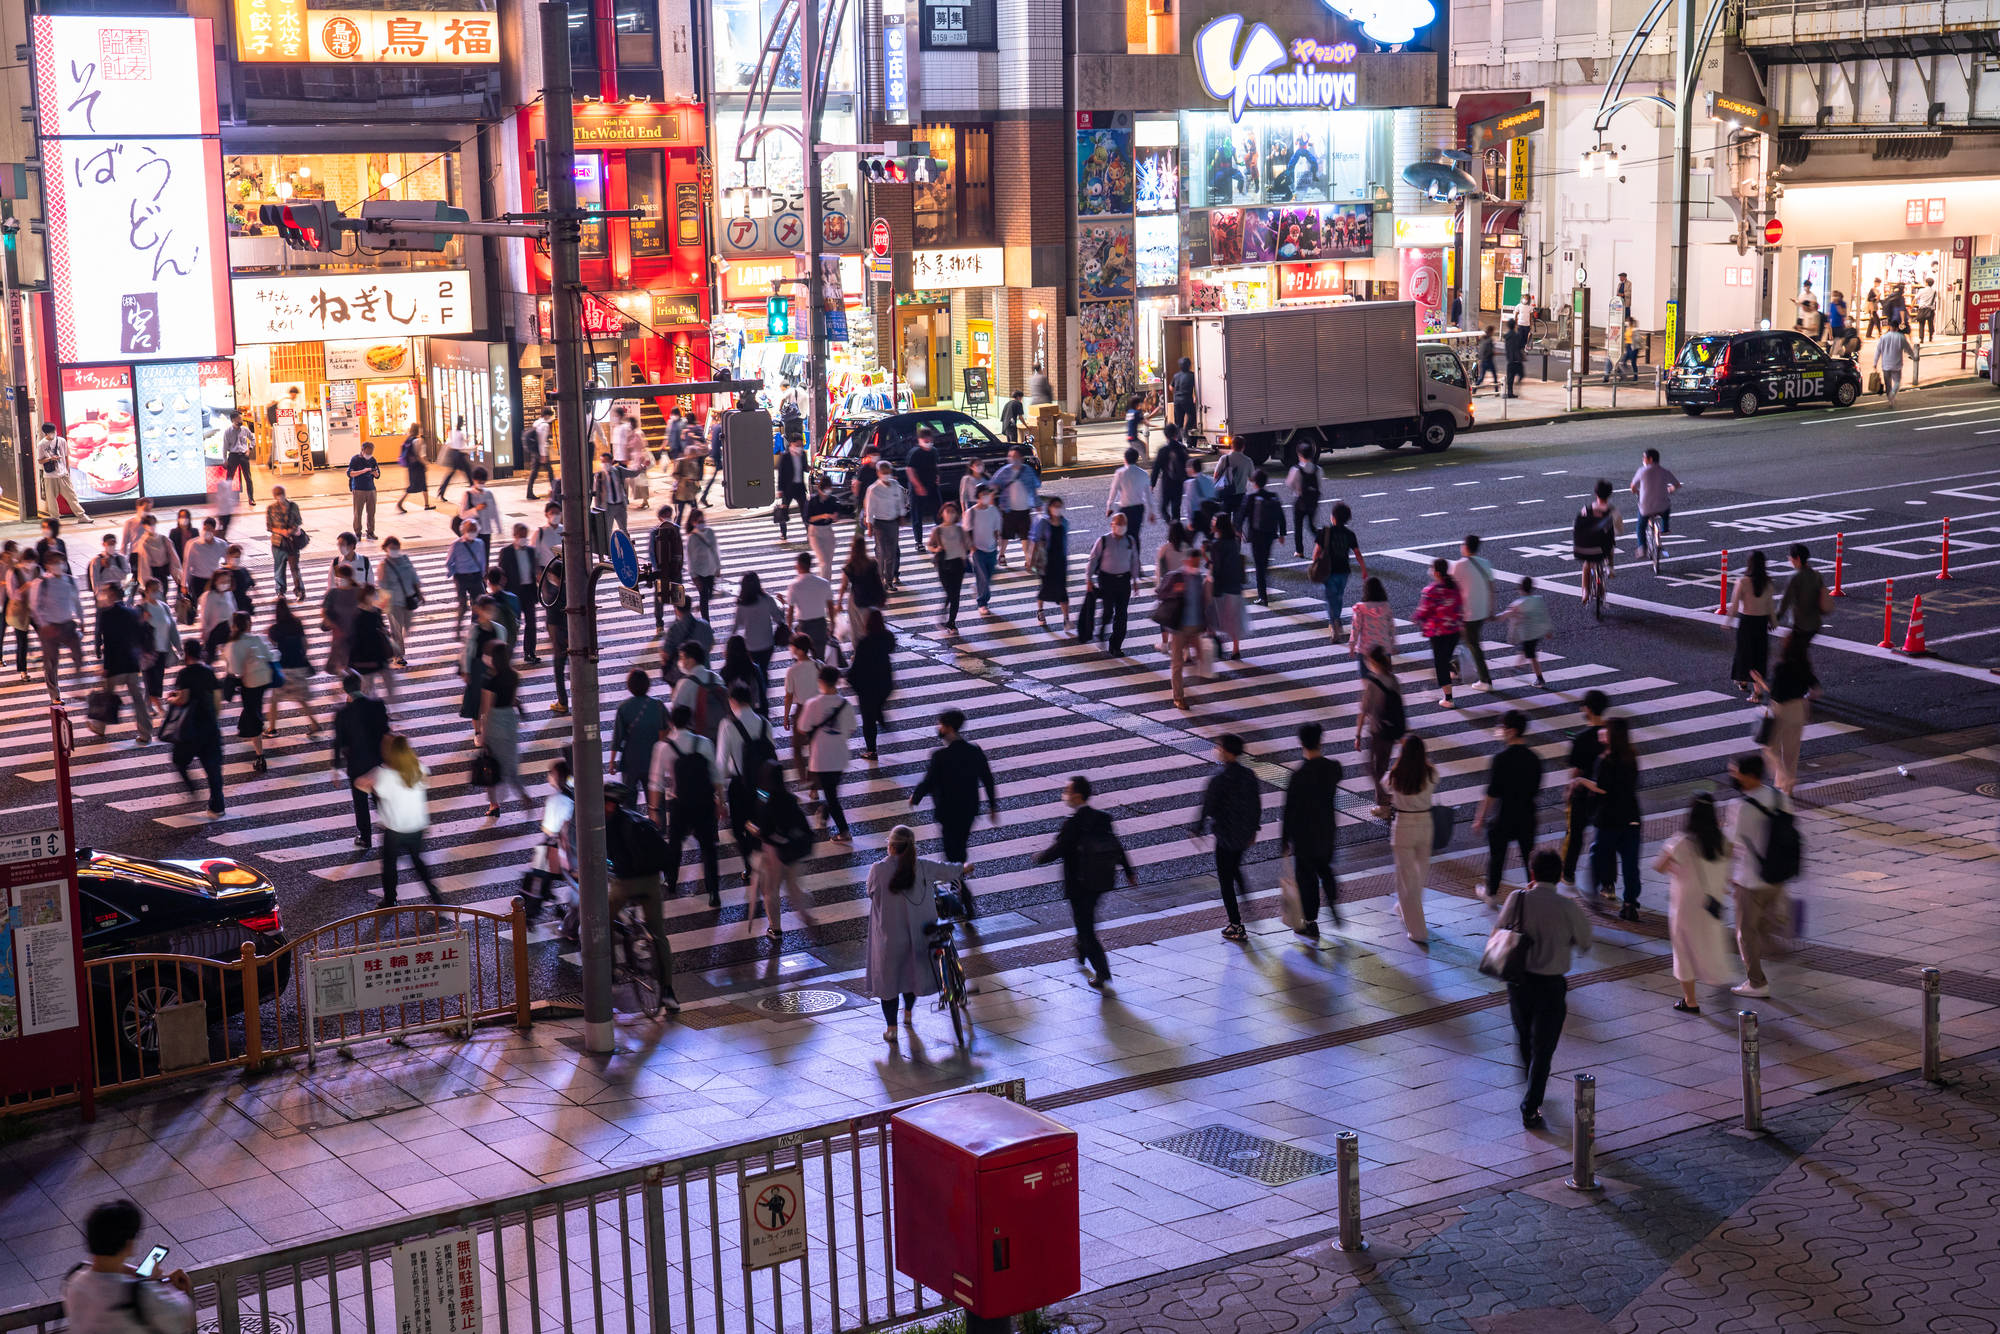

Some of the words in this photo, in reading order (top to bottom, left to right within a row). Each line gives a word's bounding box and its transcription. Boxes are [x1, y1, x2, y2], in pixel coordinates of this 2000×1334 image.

[936, 11, 962, 25] 募集
[382, 17, 491, 57] 鳥福
[932, 34, 948, 42] 5159
[1196, 13, 1357, 124] Yamashiroya
[1707, 59, 1719, 69] 268
[1511, 72, 1521, 81] 265
[573, 127, 597, 139] The
[597, 126, 635, 139] World
[637, 125, 662, 138] End
[1514, 138, 1525, 191] カレー専門店
[255, 290, 290, 302] 牛たん
[438, 281, 454, 325] 2F
[657, 296, 667, 304] 2F
[274, 304, 303, 316] とろろ
[309, 285, 417, 330] ねぎし
[656, 306, 678, 316] Irish
[679, 305, 697, 315] Pub
[10, 291, 22, 344] 大江戸線近道
[266, 319, 296, 332] 麦めし
[75, 370, 120, 388] そばうどん
[142, 366, 176, 379] UDON
[190, 364, 219, 376] SOBA
[494, 364, 505, 391] 牛たん
[152, 376, 200, 387] TEMPURA
[1768, 377, 1825, 400] S.RIDE
[491, 392, 511, 435] ねぎし
[297, 430, 313, 472] OPEN
[363, 948, 460, 973] 駐輪禁止
[364, 961, 460, 981] 放置自転車は区条例に
[365, 972, 438, 988] 基づき撤去します
[401, 992, 424, 1001] 台東区
[752, 1227, 801, 1246] 路上ライブ禁止
[435, 1246, 444, 1305] ことを禁止します
[456, 1240, 476, 1330] 無断駐車禁止
